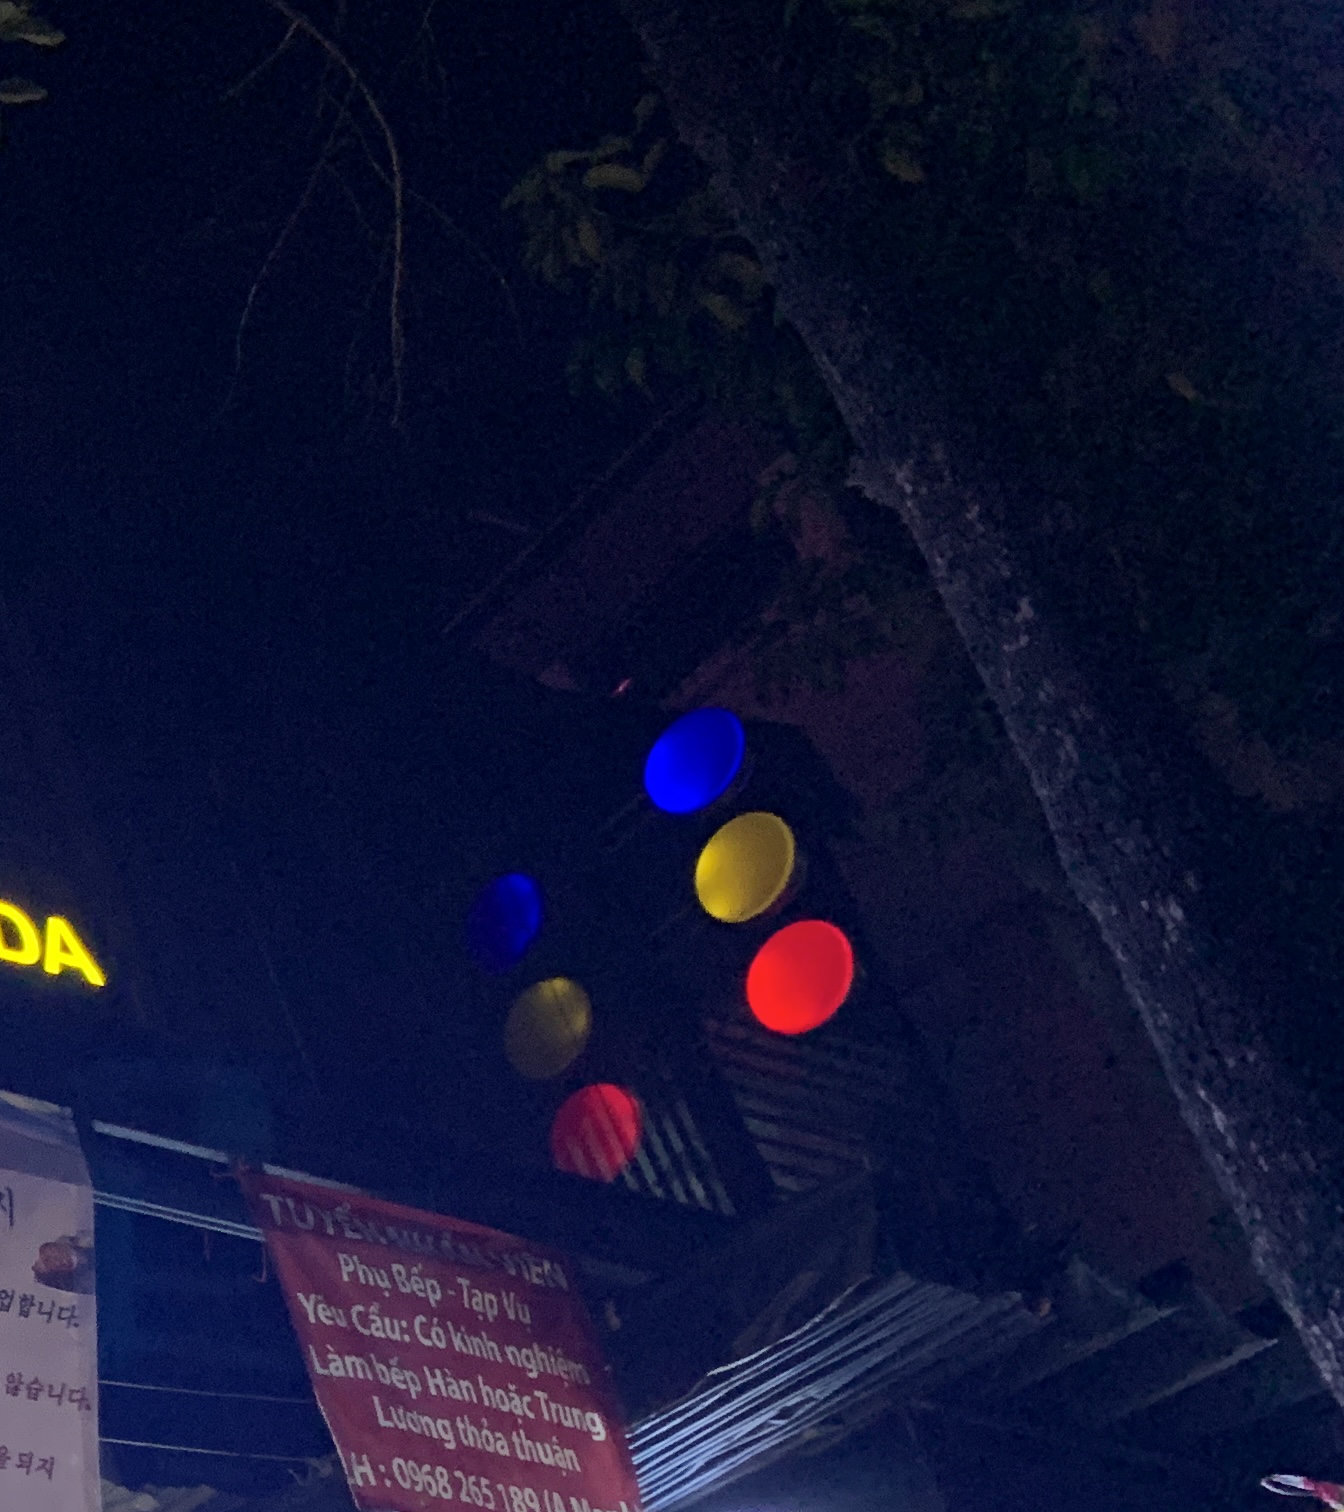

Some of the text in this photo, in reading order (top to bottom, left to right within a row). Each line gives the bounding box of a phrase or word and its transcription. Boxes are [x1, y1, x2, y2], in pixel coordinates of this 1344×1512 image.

[337, 1251, 390, 1297] Phụ
[391, 1262, 443, 1308] Bếp
[456, 1275, 499, 1323] Tạp
[502, 1290, 532, 1334] Vụ
[414, 1314, 446, 1350] Có
[447, 1321, 503, 1363] kinh
[309, 1342, 374, 1379] Làm
[370, 1353, 422, 1400] bếp
[423, 1365, 478, 1404] Hàn
[534, 1391, 608, 1442] Trung
[511, 1428, 582, 1478] thuận
[391, 1457, 454, 1500] 0968
[454, 1470, 496, 1512] 265
